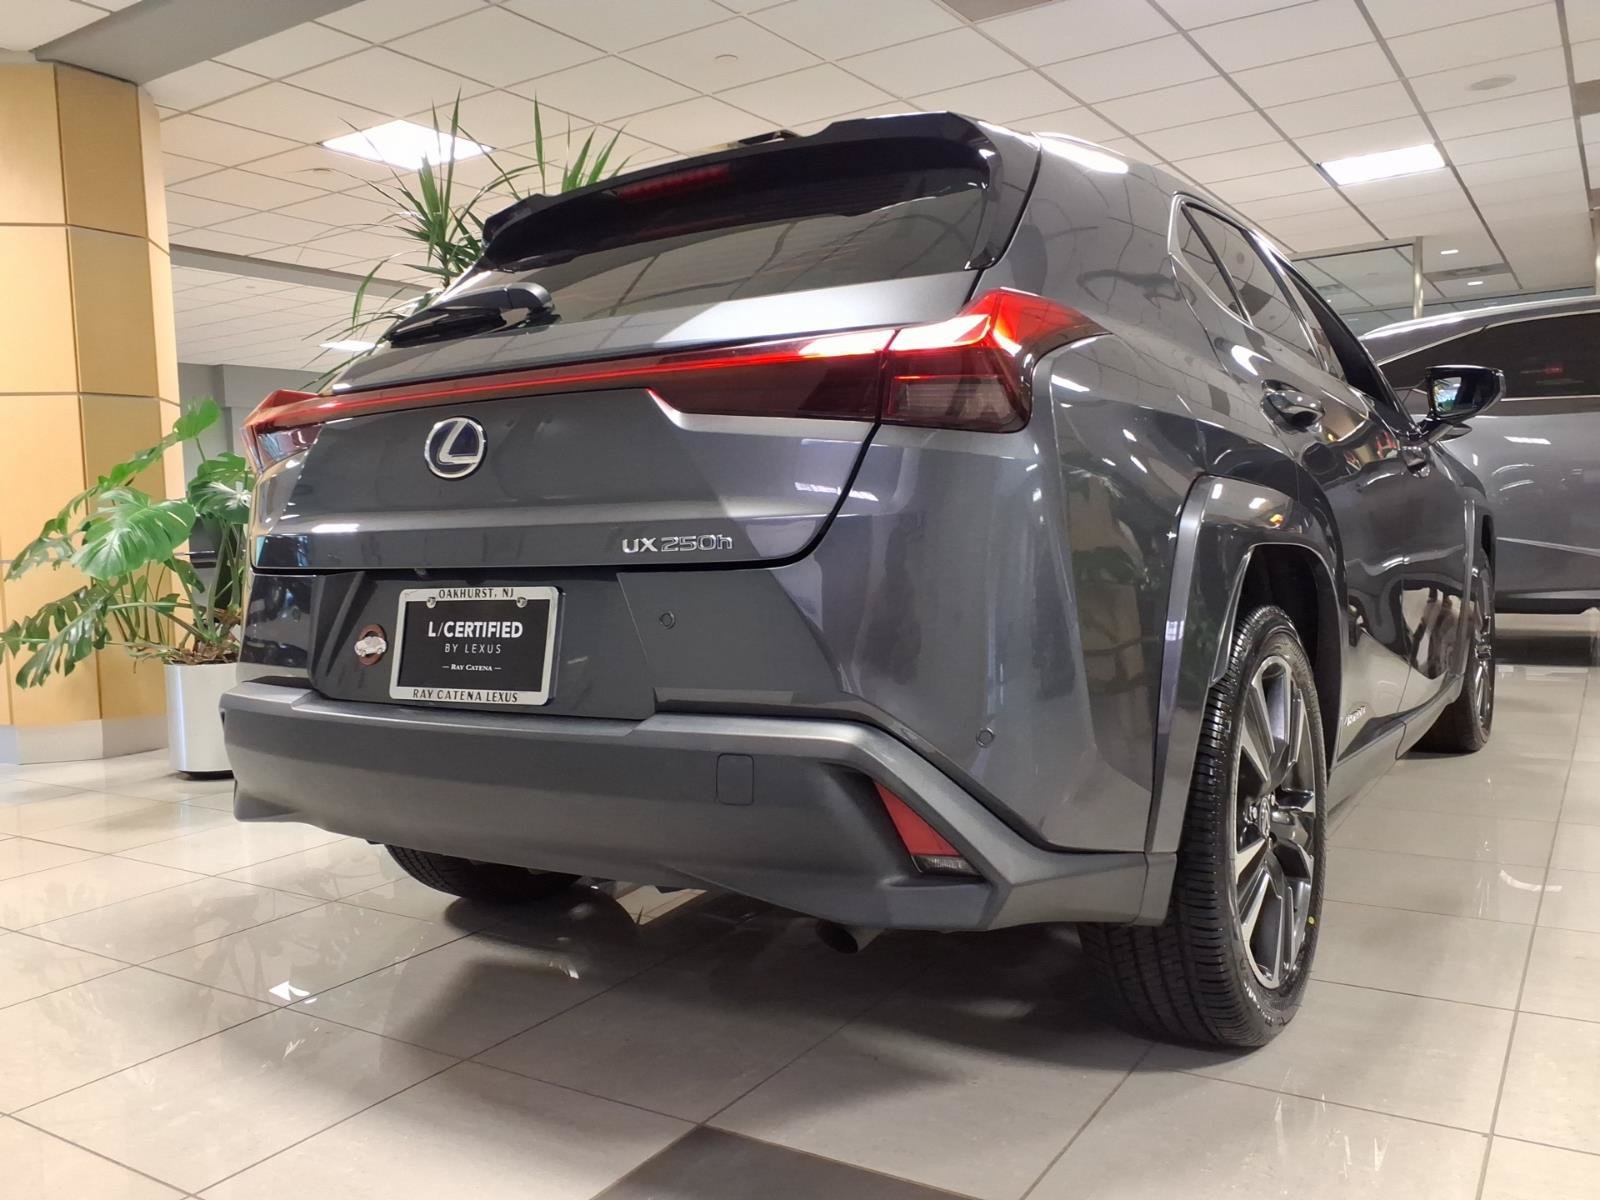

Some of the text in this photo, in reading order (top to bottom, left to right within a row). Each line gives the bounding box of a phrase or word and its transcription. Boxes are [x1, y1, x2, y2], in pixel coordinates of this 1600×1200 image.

[622, 534, 733, 554] UX 250h
[438, 587, 514, 600] OAKHURST, NJ
[427, 621, 524, 639] L/CERTIFIED
[444, 643, 503, 654] BY LEXUS
[412, 688, 519, 703] RAY CATENA LEXUS
